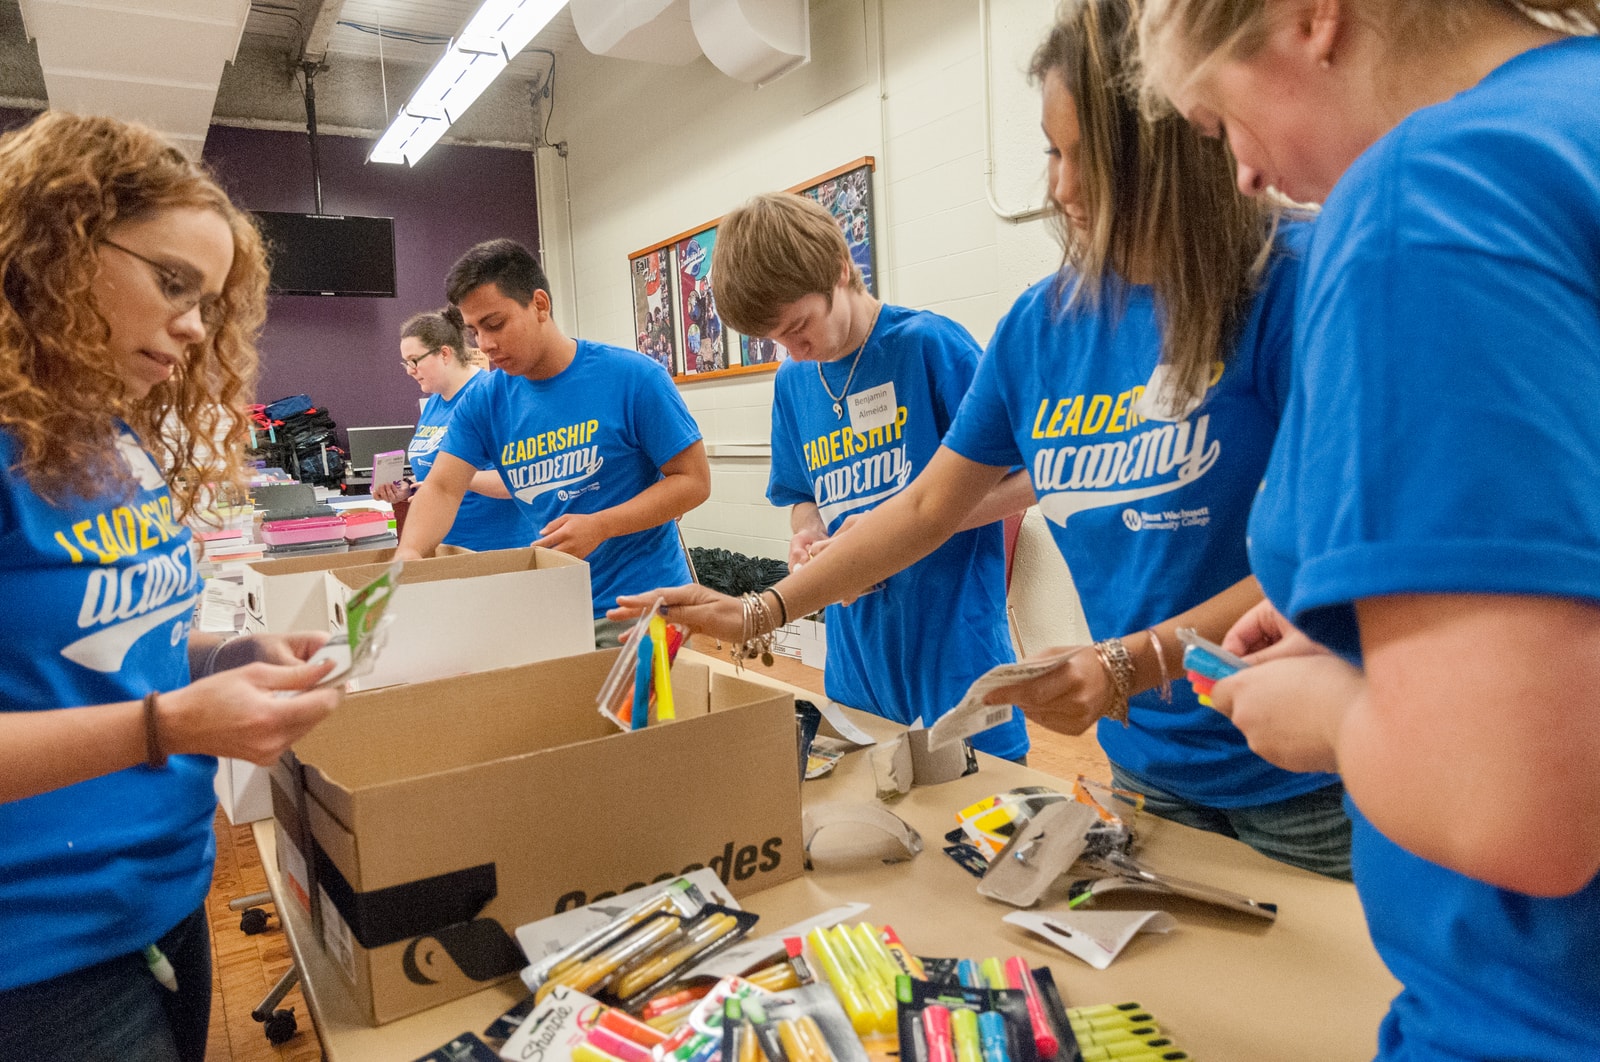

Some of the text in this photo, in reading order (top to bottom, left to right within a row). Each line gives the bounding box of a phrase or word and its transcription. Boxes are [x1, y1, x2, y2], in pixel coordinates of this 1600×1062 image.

[854, 389, 888, 407] Benjamin
[858, 404, 888, 419] Almeida
[501, 419, 599, 466] LEADERSHIP
[521, 1006, 574, 1062] Sharpie
